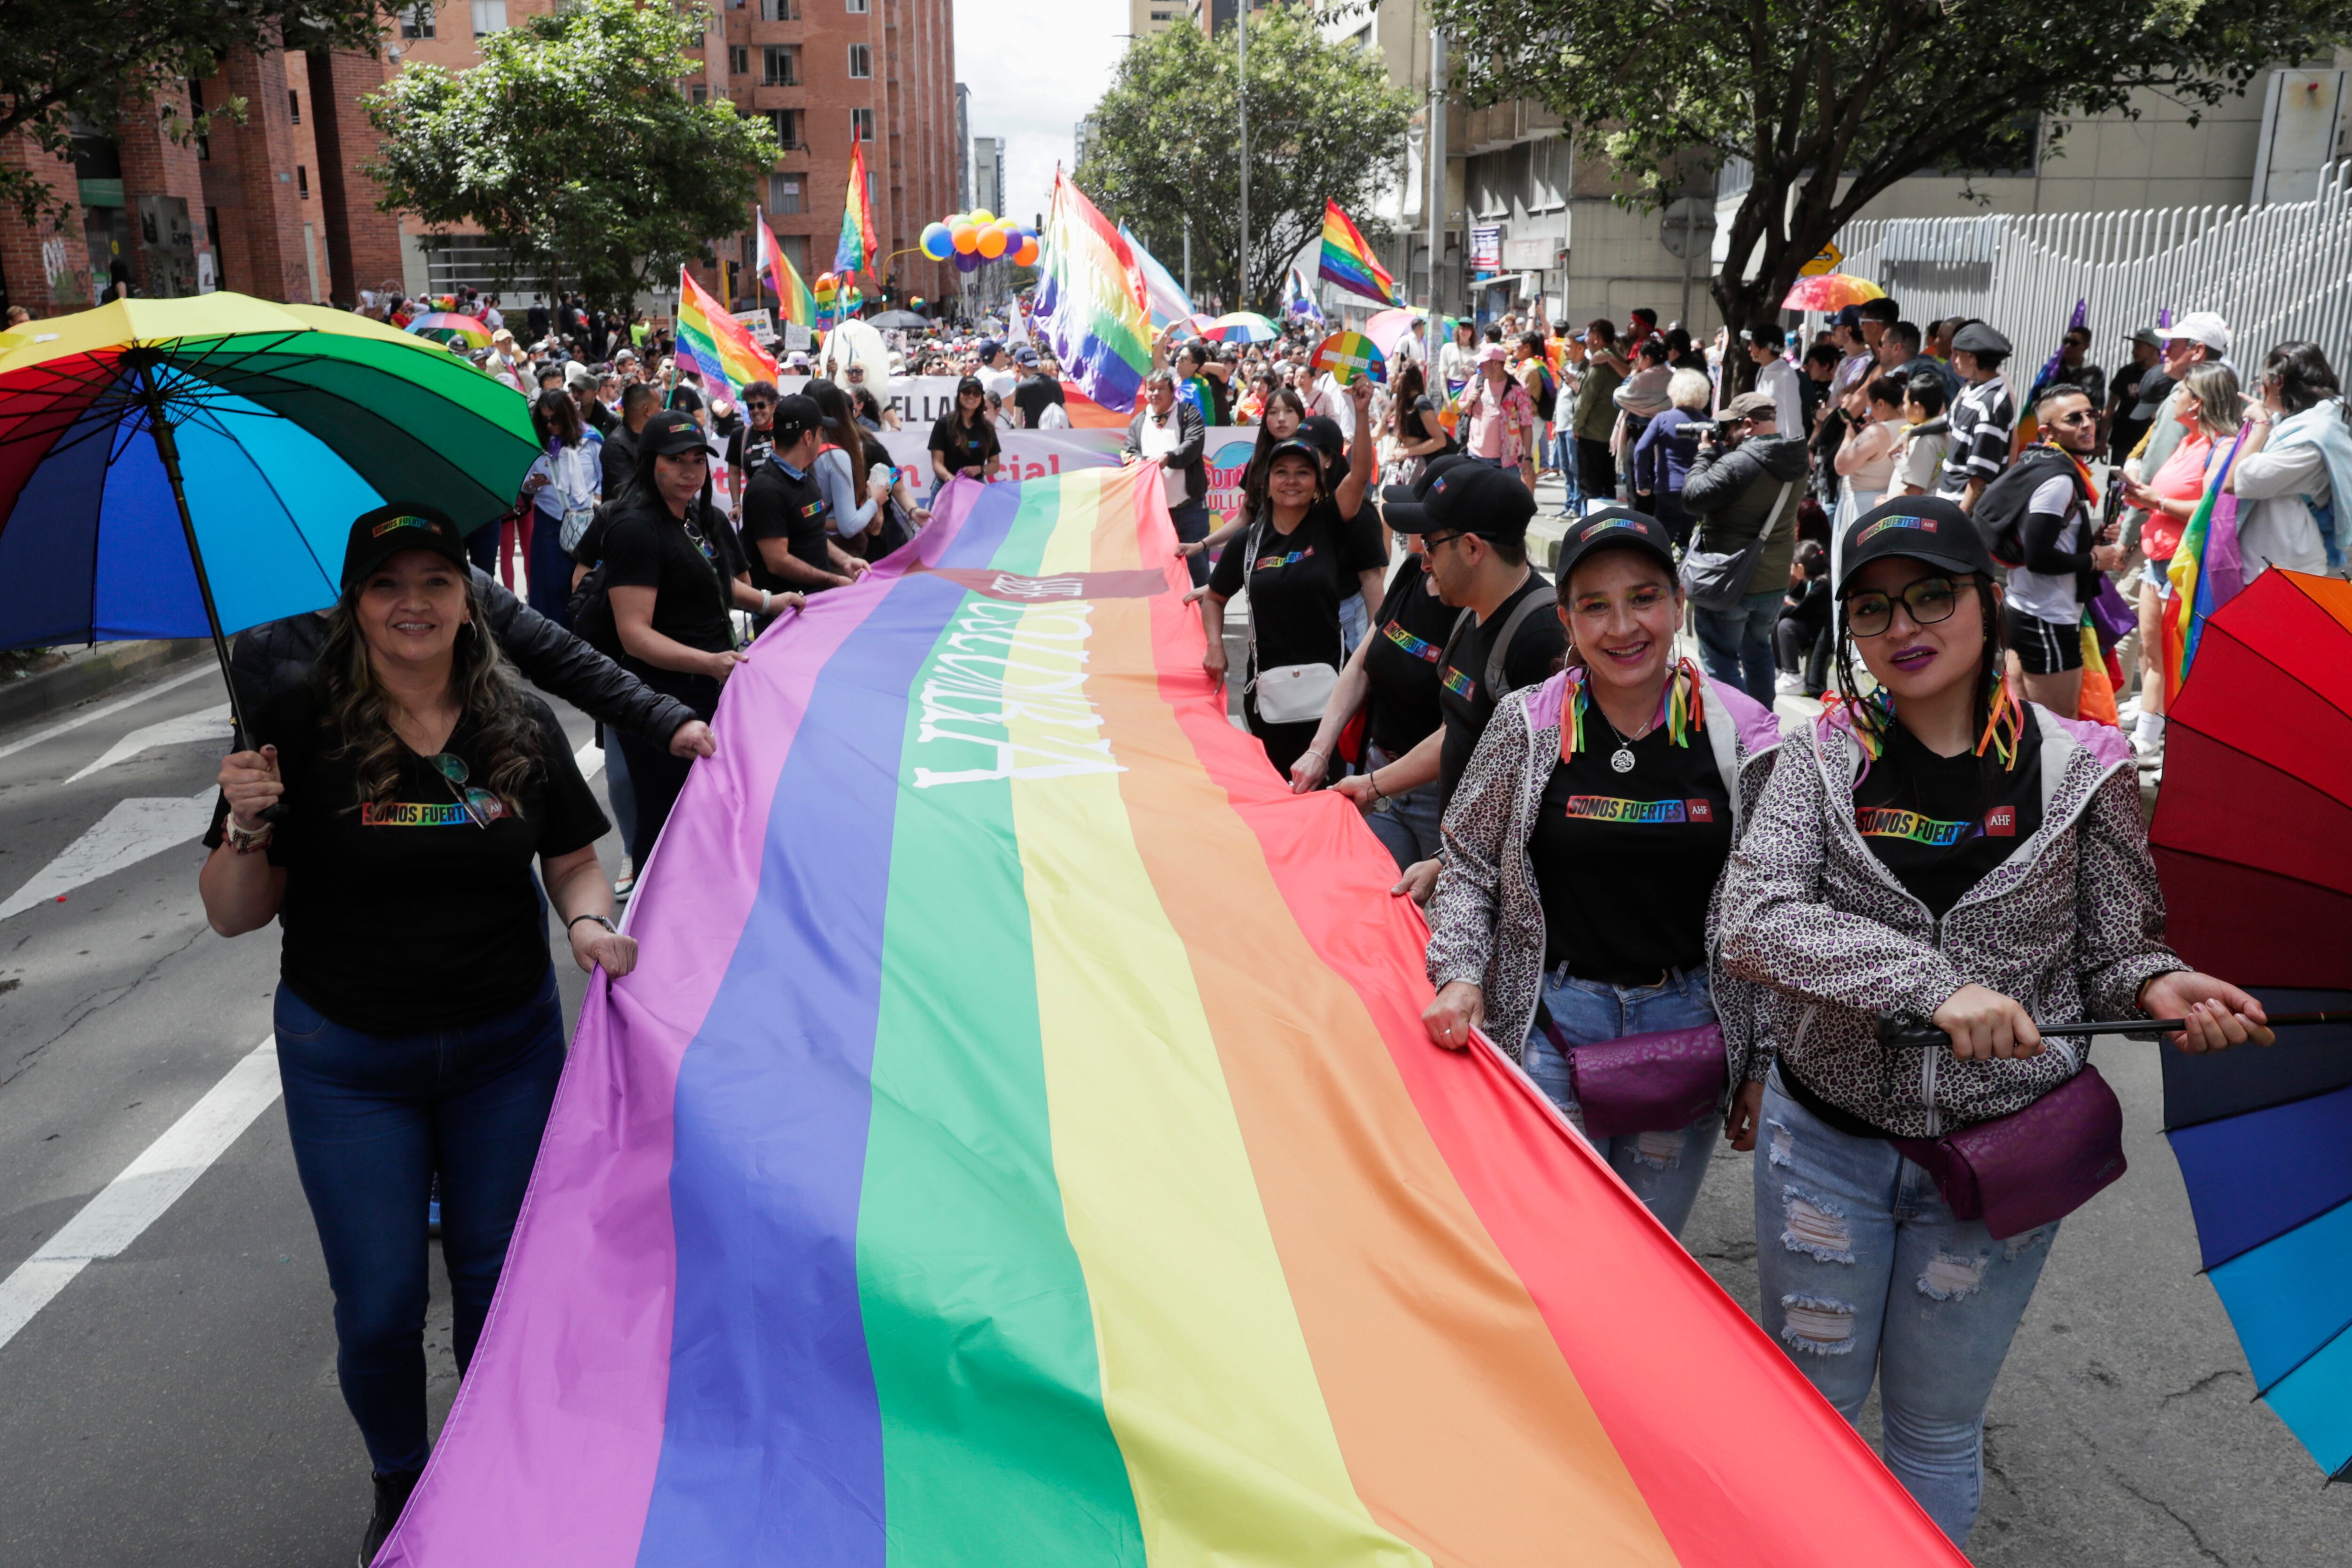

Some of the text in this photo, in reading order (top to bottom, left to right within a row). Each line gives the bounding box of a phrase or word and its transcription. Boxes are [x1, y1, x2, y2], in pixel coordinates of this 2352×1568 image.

[1321, 350, 1343, 363] SOMOS
[1344, 355, 1369, 369] FUERTES
[890, 396, 917, 422] EL
[1582, 522, 1603, 540] SOMOS
[1604, 519, 1635, 528] FUERTES
[1859, 523, 1881, 544] SOMOS
[1882, 518, 1918, 529] FUERTES
[366, 805, 418, 823] SOMOS
[1569, 798, 1708, 820] SOMOS FUERTES AHF
[1859, 810, 1914, 835] SOMOS
[1990, 814, 2010, 826] AHF
[2095, 1159, 2116, 1180] TOTTO
